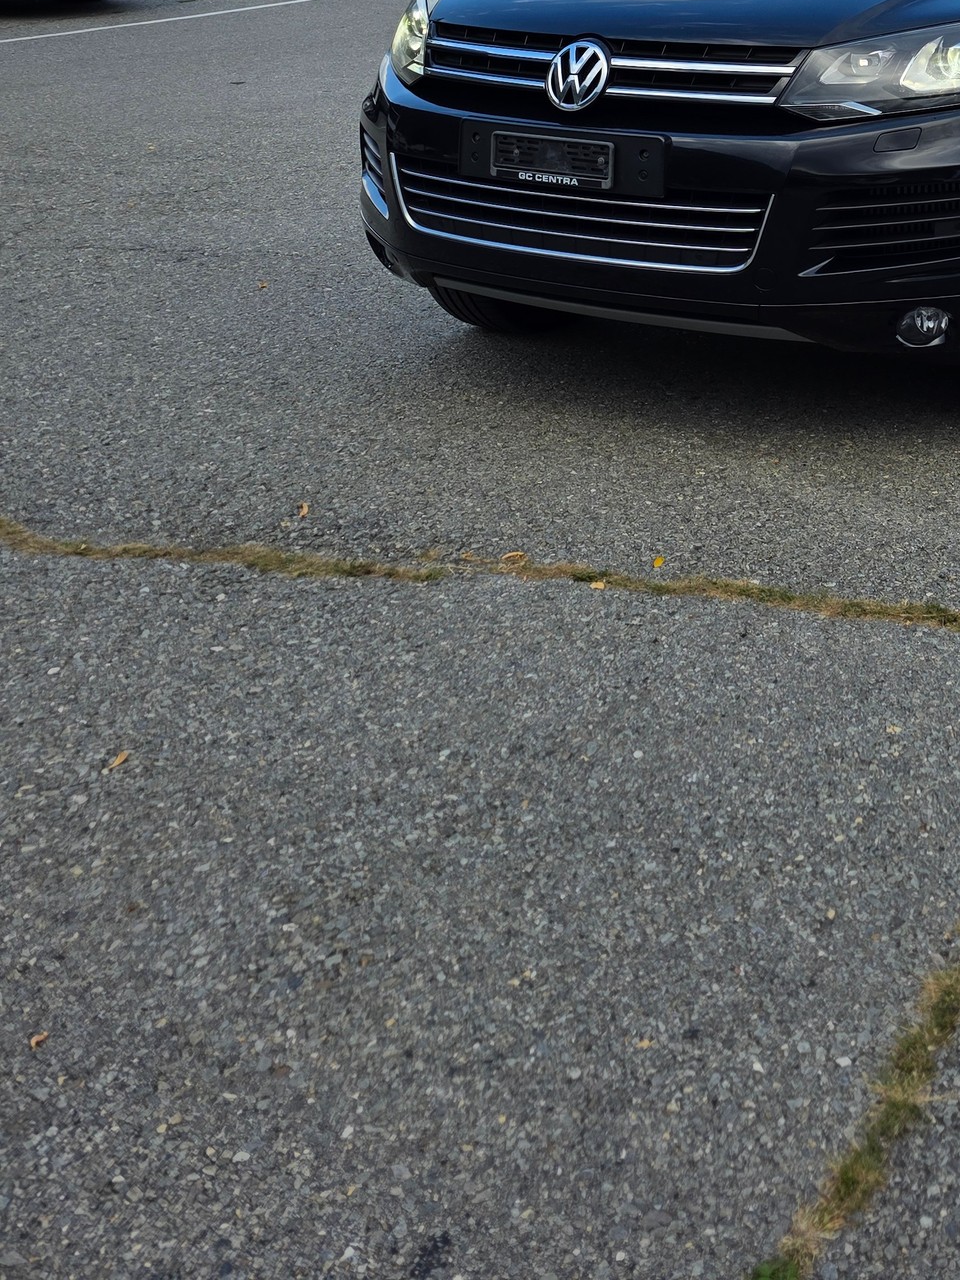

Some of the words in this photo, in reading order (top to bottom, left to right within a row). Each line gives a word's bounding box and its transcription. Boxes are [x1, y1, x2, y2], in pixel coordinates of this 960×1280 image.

[546, 40, 609, 111] VW
[518, 172, 533, 182] GC
[535, 174, 579, 186] CENTRA
